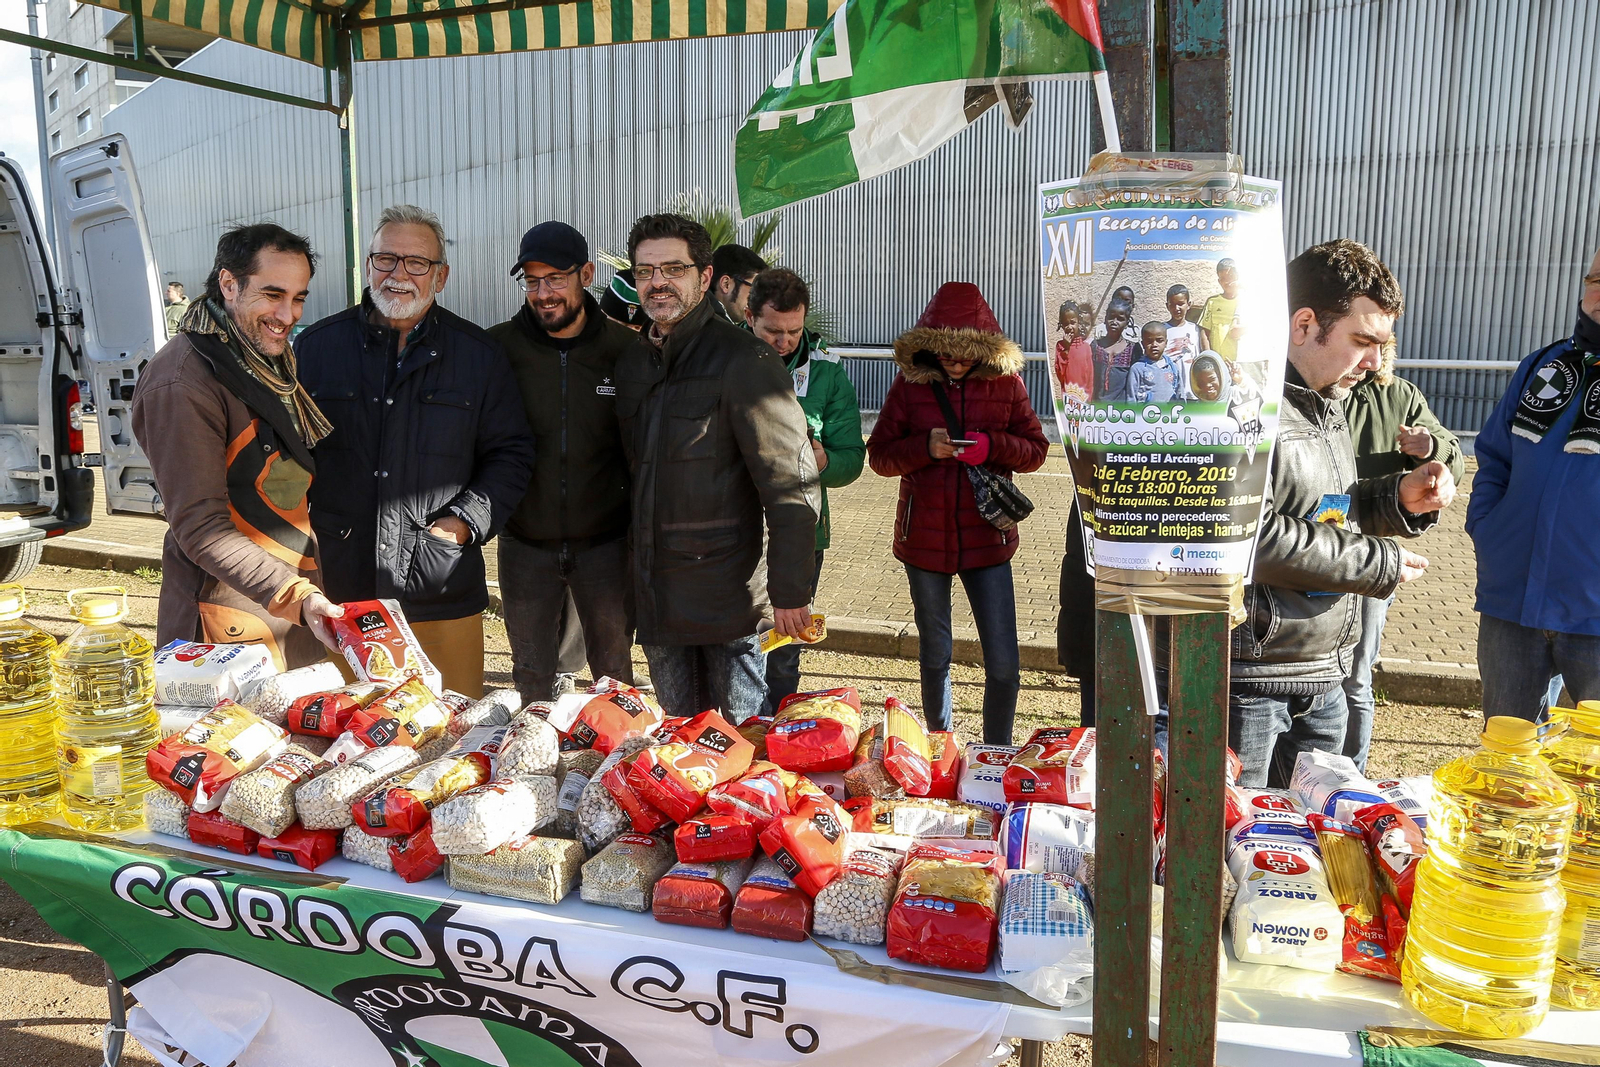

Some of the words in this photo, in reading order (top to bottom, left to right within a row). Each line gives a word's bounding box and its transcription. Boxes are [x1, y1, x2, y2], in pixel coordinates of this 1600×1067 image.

[1098, 215, 1180, 236] Recogida
[1184, 214, 1208, 231] de
[1211, 216, 1235, 232] ali
[1045, 217, 1094, 279] XVII
[1125, 243, 1163, 251] Asociación
[1163, 243, 1199, 251] Cordobesa
[1085, 425, 1178, 447] Albacete
[1184, 426, 1266, 450] Balompié
[1106, 452, 1148, 463] Estadio
[1150, 453, 1161, 463] El
[1163, 453, 1214, 465] Arcángel
[1098, 465, 1117, 481] de
[1121, 466, 1192, 484] Febrero,
[1196, 466, 1238, 482] 2019
[1101, 484, 1111, 493] a
[1113, 481, 1133, 494] las
[1136, 482, 1176, 494] 18:00
[1178, 482, 1217, 494] horas
[1101, 494, 1116, 505] las
[1119, 495, 1170, 508] taquillas.
[1174, 496, 1208, 507] Desde
[1210, 496, 1227, 507] las
[1095, 507, 1142, 521] Alimentos
[1145, 513, 1159, 521] no
[1161, 511, 1231, 524] perecederos:
[1109, 521, 1148, 536] azúcar
[1158, 522, 1204, 540] lentejas
[1214, 521, 1243, 537] harina
[1168, 566, 1222, 578] FEPAMIC
[362, 621, 386, 632] GALLO
[363, 628, 392, 640] PLUMAS
[699, 737, 726, 752] GALLO
[1257, 888, 1318, 901] ARROZ
[1271, 936, 1308, 947] ARROZ
[110, 861, 597, 999] CÓRDOBA
[610, 955, 820, 1054] C.F.
